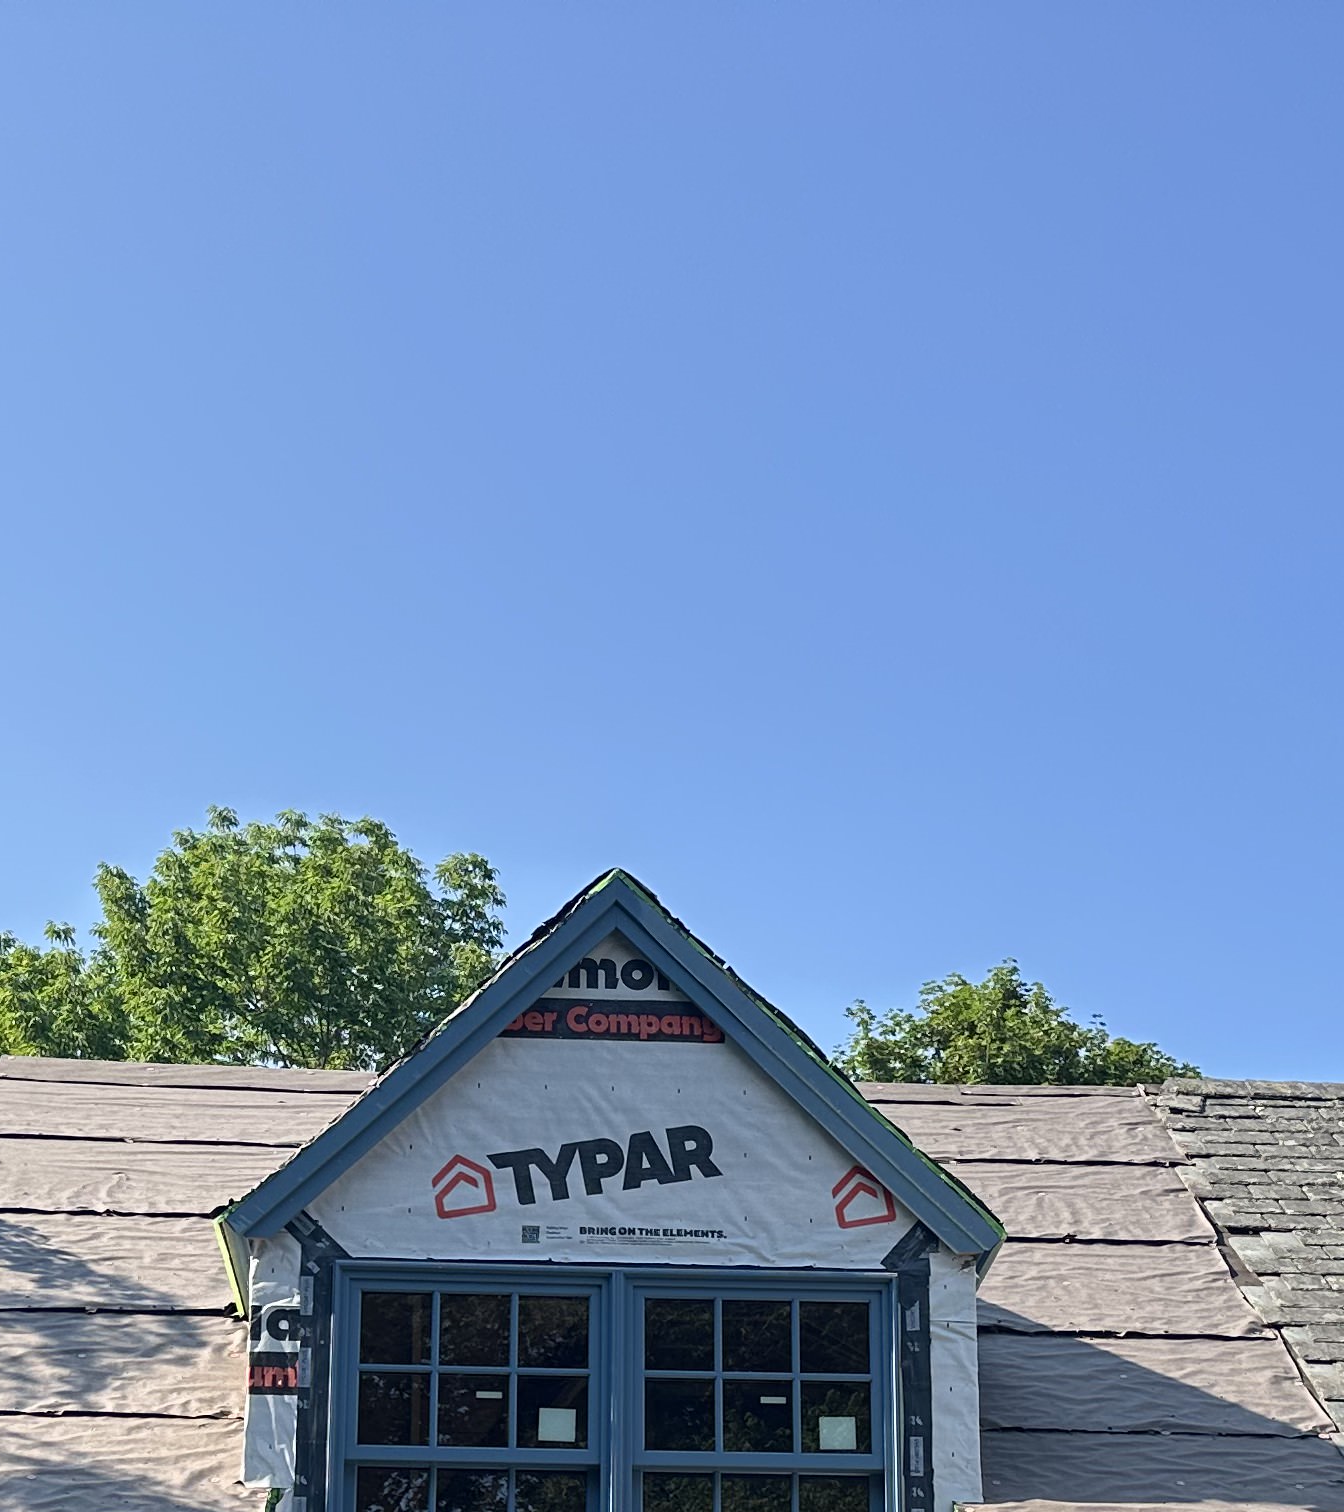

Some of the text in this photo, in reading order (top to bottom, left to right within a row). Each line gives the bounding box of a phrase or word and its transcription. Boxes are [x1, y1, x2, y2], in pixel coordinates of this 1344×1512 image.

[486, 1125, 724, 1206] TYPAR
[579, 1226, 617, 1236] BRING
[618, 1226, 636, 1236] ON
[637, 1227, 661, 1237] THE
[662, 1228, 728, 1239] ELEMENTS.
